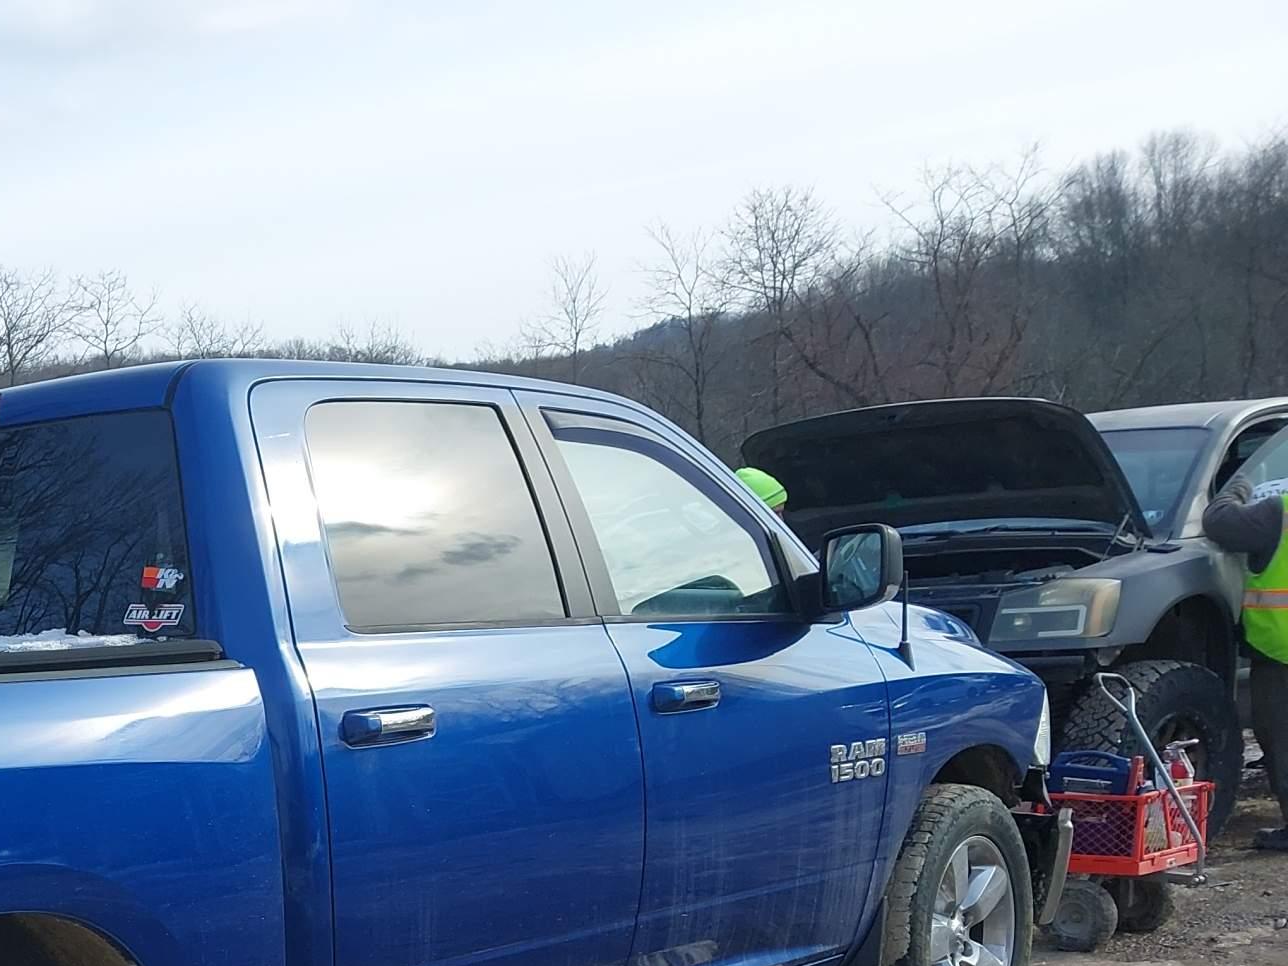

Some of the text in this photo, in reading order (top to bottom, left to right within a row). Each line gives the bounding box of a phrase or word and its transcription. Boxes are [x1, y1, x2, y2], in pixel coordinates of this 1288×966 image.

[128, 609, 180, 620] AIR LIFT
[830, 738, 886, 763] RAM
[831, 758, 886, 784] 1500
